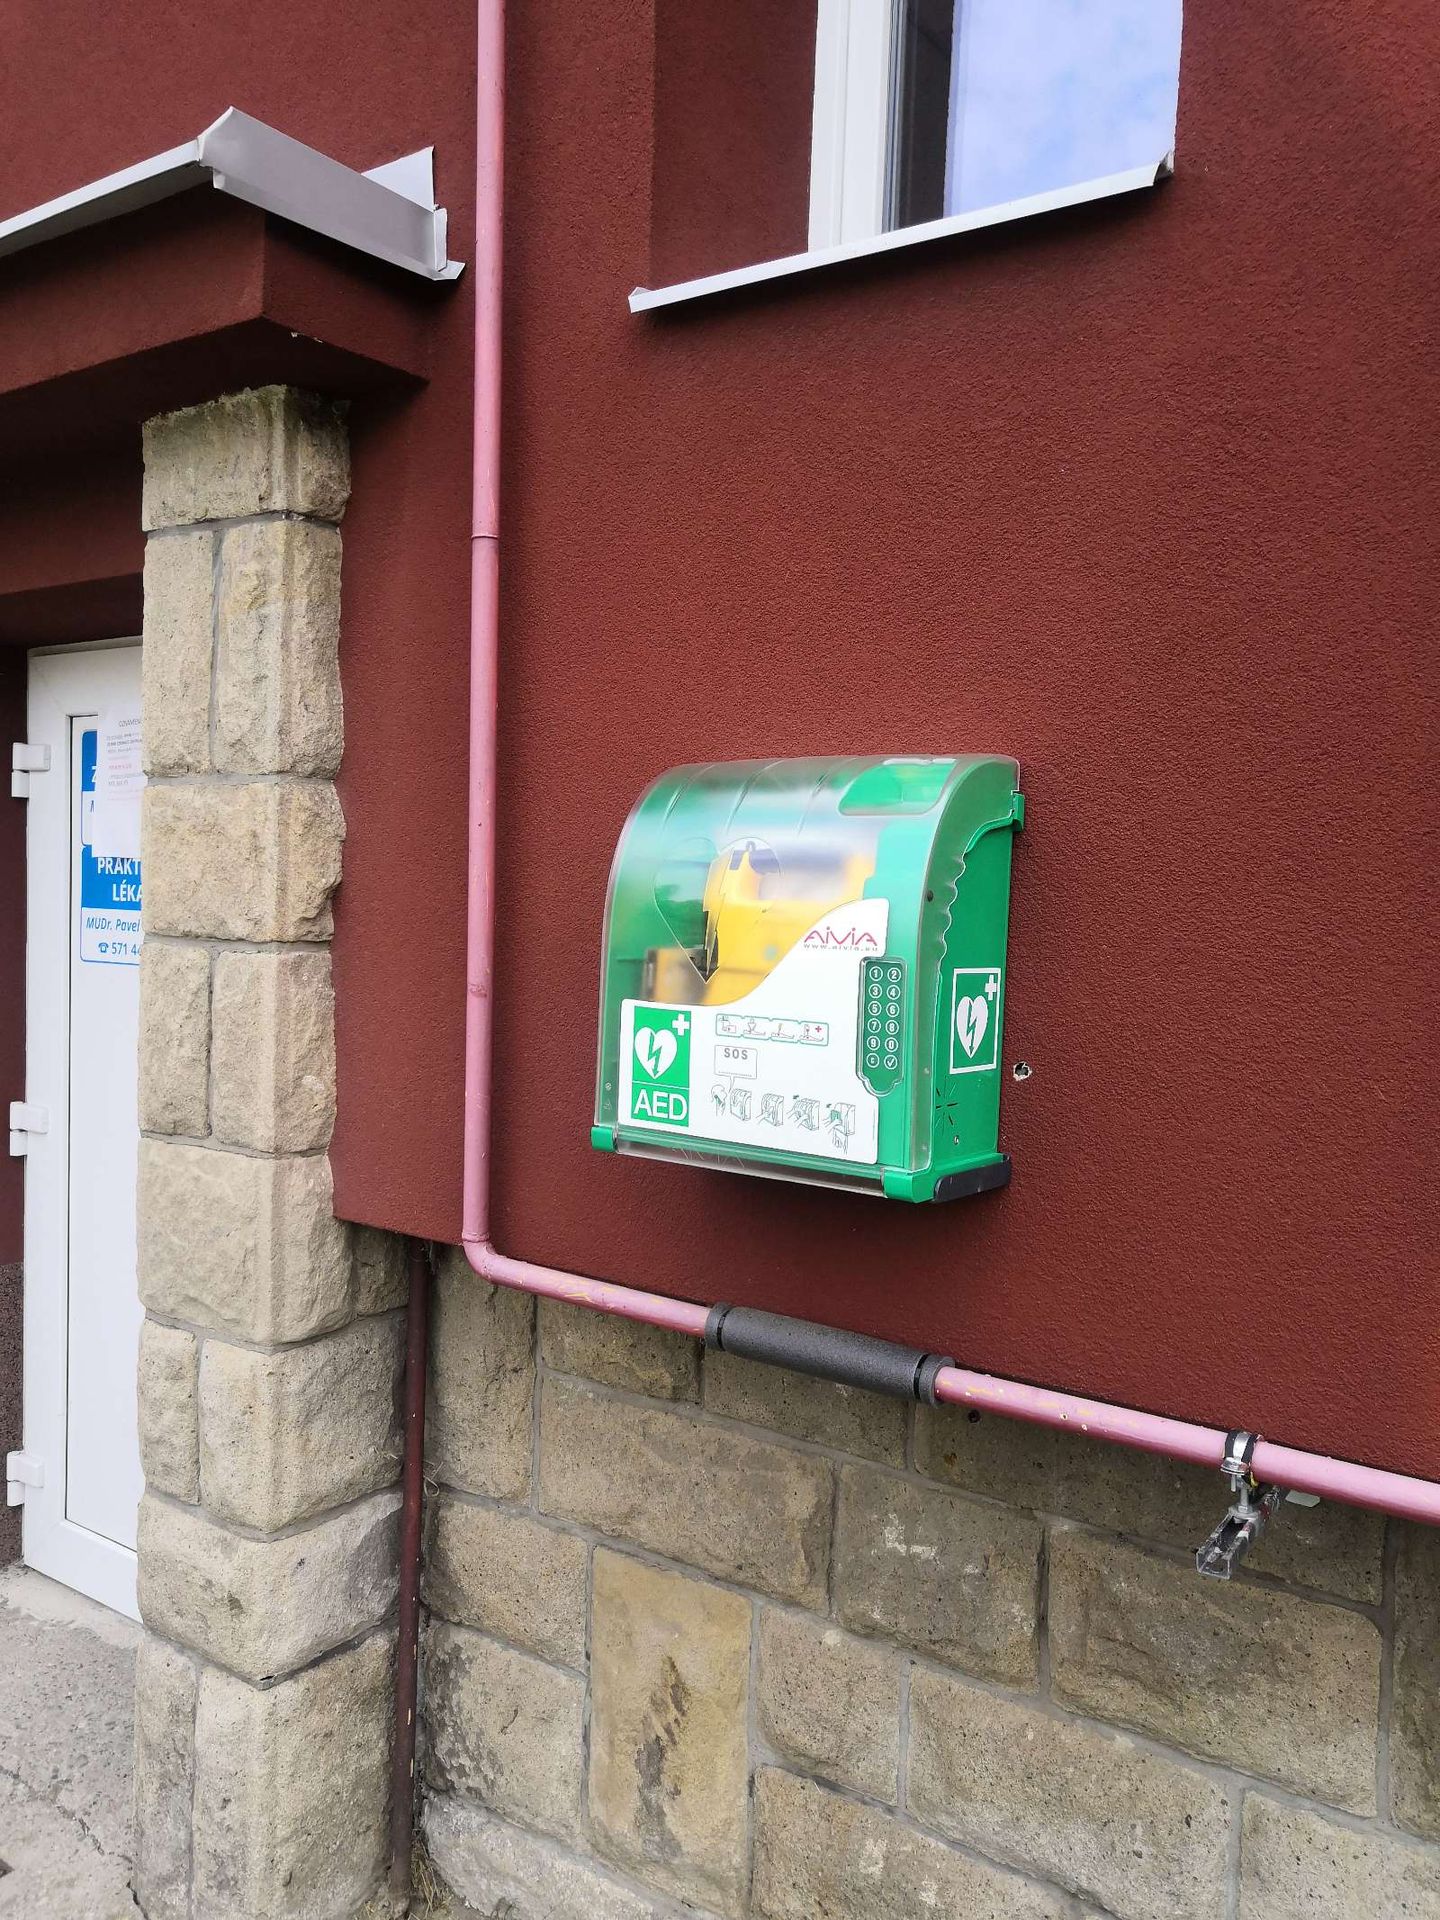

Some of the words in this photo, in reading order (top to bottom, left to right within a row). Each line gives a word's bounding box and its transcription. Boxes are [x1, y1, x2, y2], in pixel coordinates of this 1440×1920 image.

[97, 857, 141, 875] PRAKT
[86, 917, 112, 930] MUDr.
[116, 919, 140, 932] Pavel
[112, 942, 127, 955] 571
[724, 1048, 748, 1060] SOS
[633, 1088, 688, 1121] AED
